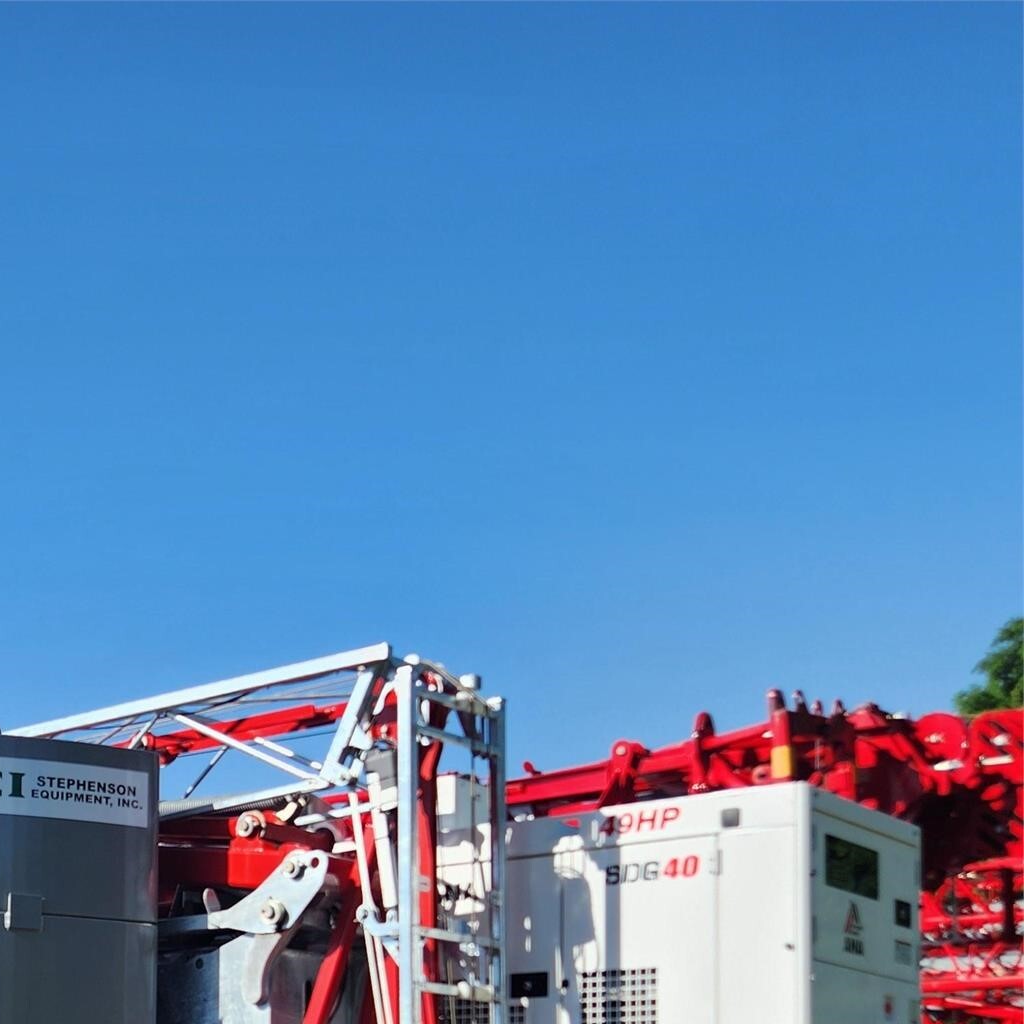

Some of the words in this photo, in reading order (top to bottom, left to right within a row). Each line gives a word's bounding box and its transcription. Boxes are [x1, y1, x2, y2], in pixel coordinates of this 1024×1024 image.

[37, 776, 136, 796] STEPHENSON
[32, 789, 113, 807] EQUIPMENT,
[117, 797, 144, 811] INC.
[599, 806, 680, 836] 49HP
